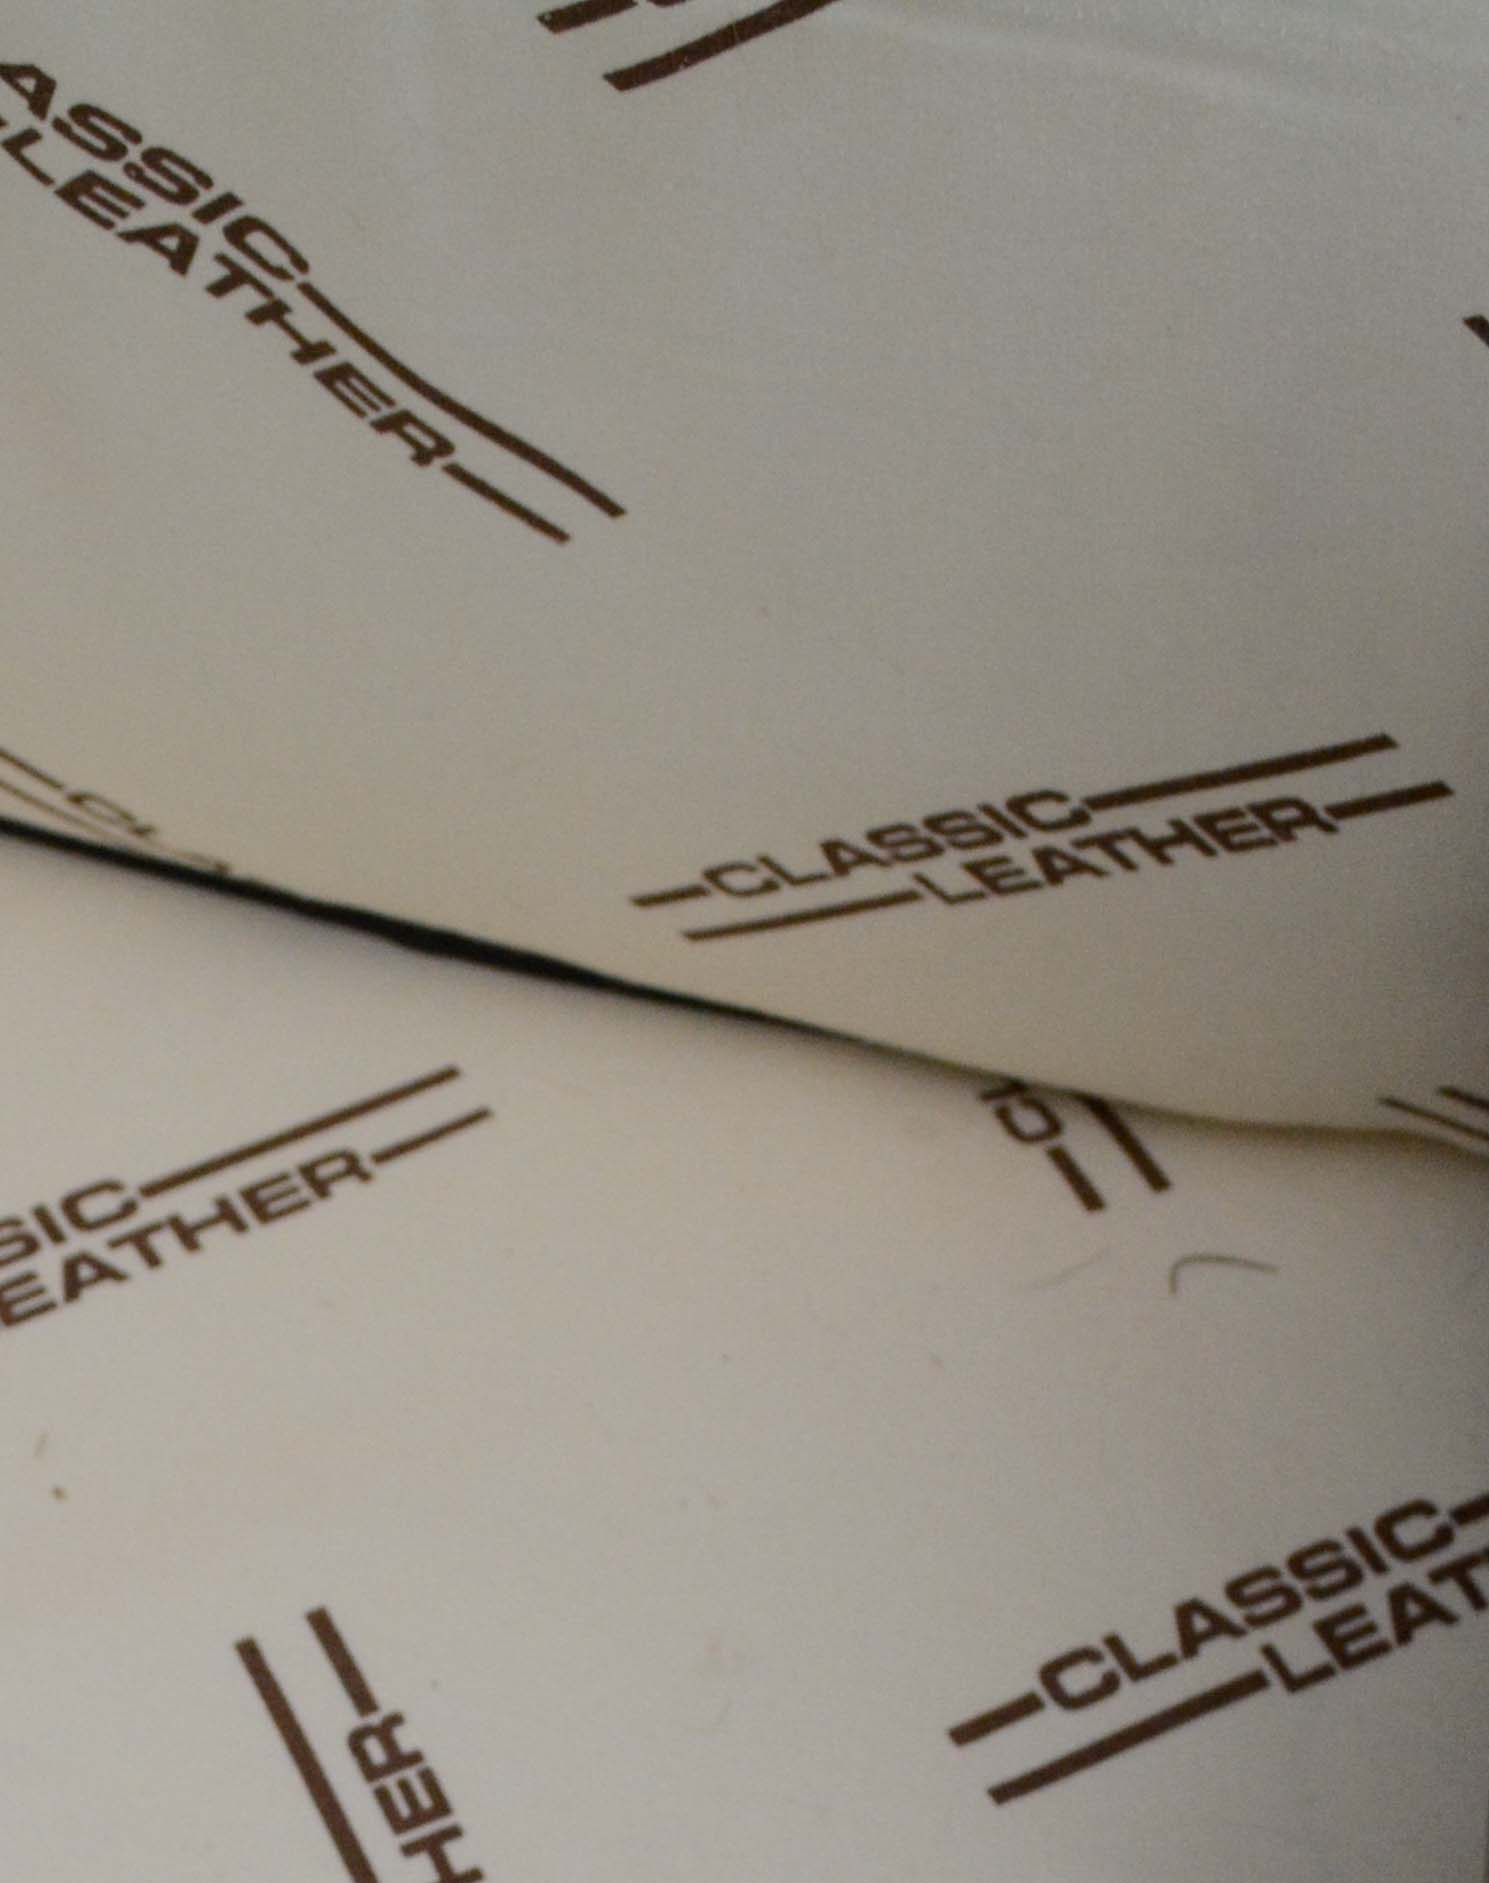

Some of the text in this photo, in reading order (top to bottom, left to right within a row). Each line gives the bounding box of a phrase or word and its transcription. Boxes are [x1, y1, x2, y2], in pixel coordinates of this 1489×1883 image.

[1, 128, 456, 467] LEATHER
[701, 788, 1096, 902] CLASSIC
[915, 796, 1342, 906] LEATHER
[1036, 1498, 1455, 1711] CLASSIC
